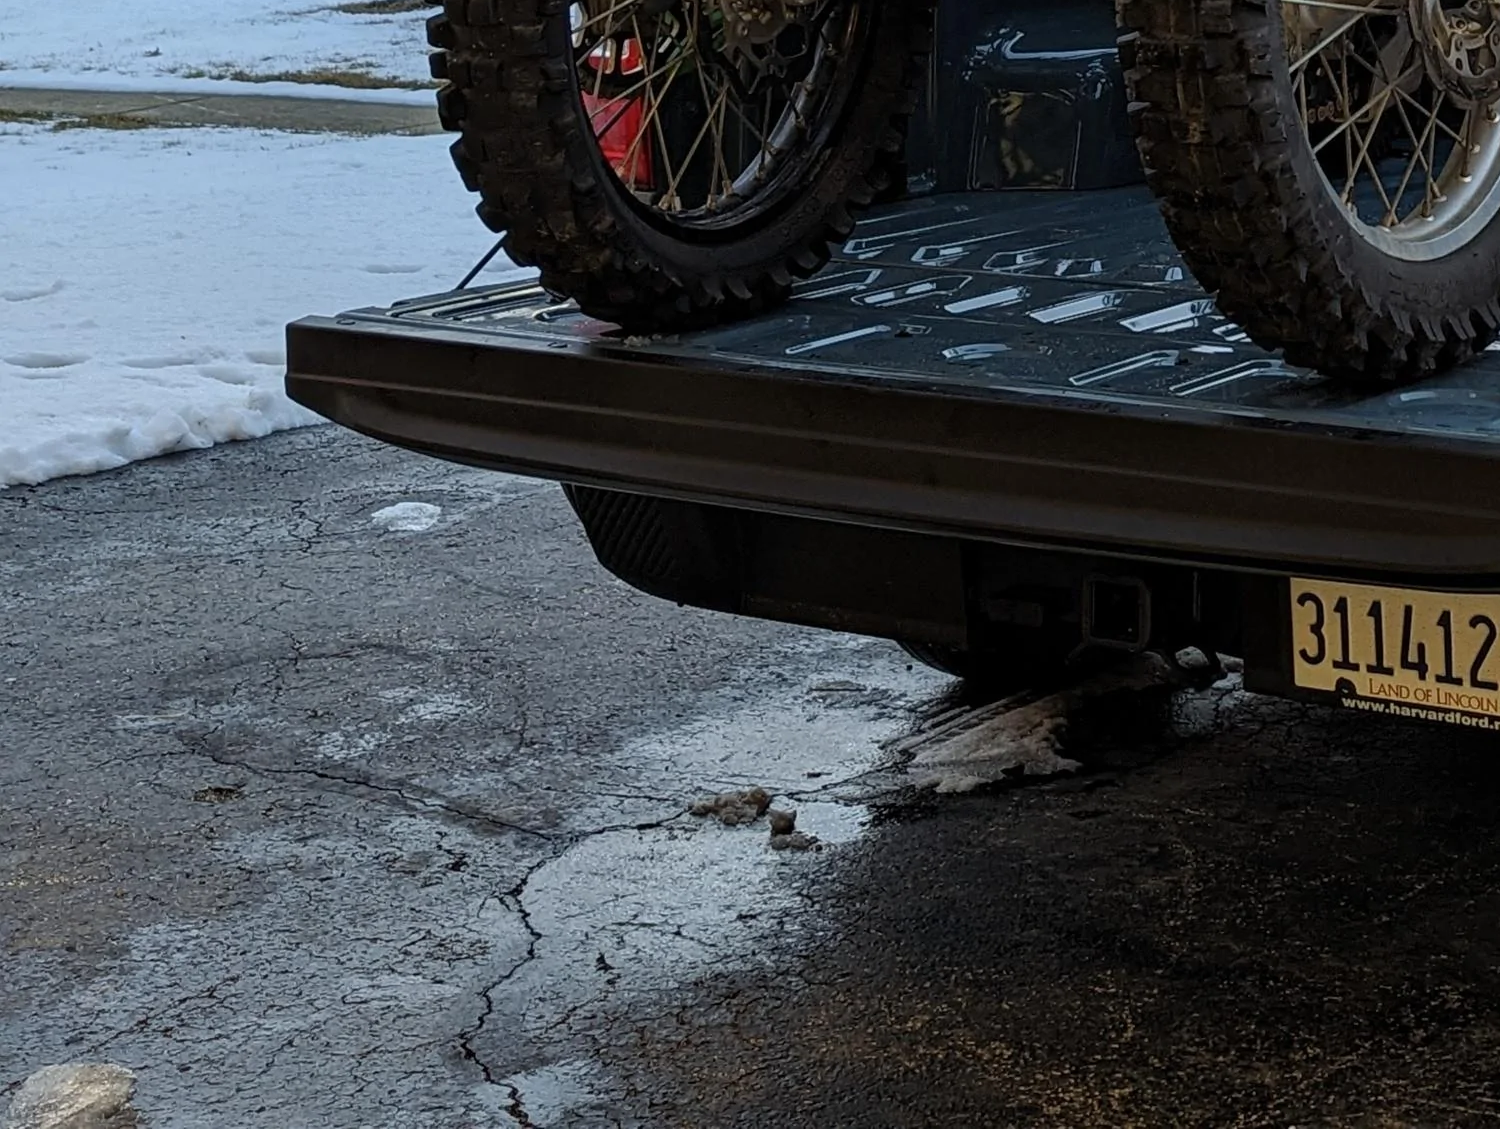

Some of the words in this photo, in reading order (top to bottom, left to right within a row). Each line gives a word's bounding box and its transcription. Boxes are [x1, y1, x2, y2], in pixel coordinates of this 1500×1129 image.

[1369, 678, 1410, 699] LAND
[1414, 687, 1432, 702] OF
[1436, 688, 1498, 712] LINCOLN
